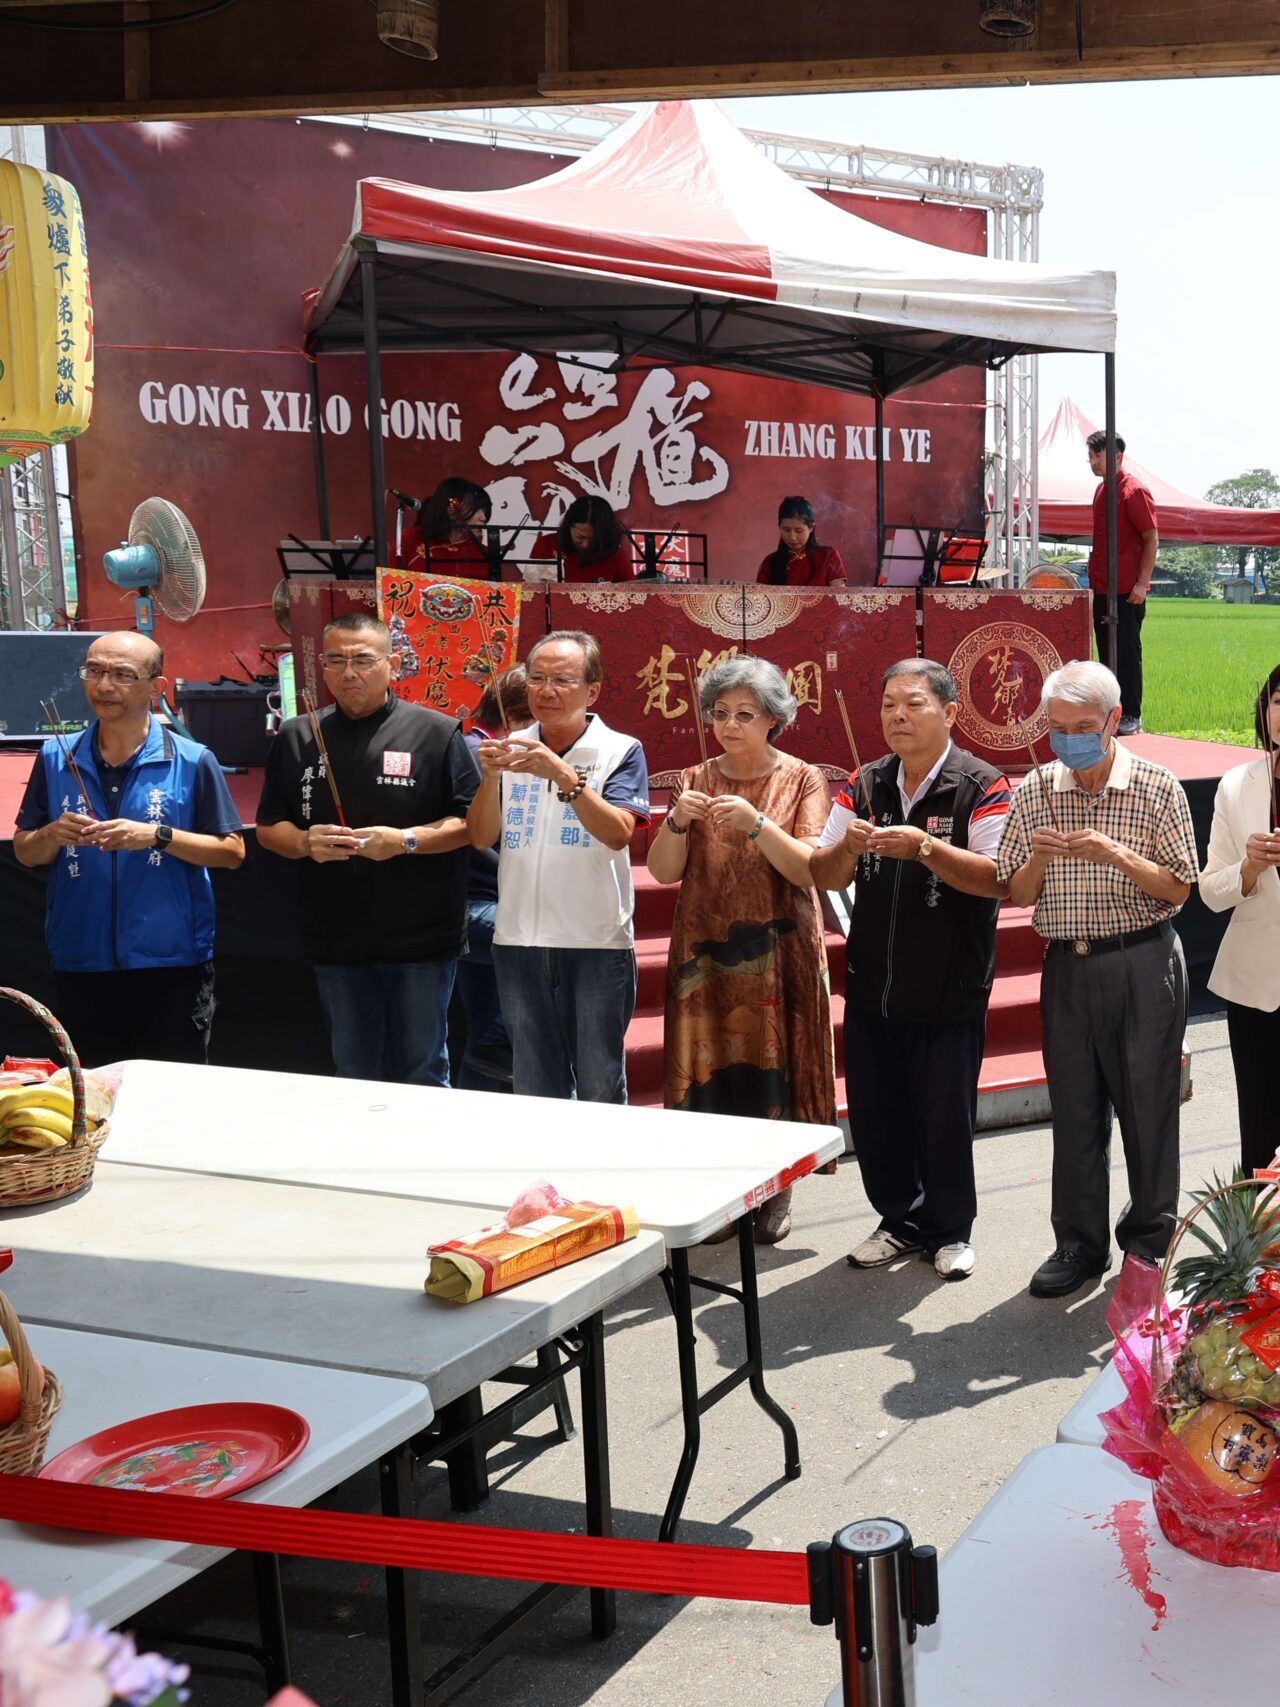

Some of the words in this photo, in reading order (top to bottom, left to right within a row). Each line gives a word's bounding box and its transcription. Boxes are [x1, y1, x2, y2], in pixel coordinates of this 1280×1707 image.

[138, 381, 250, 430] GONG
[744, 420, 837, 460] ZHANG
[900, 428, 932, 464] YE
[504, 783, 528, 849] 蕭德恕
